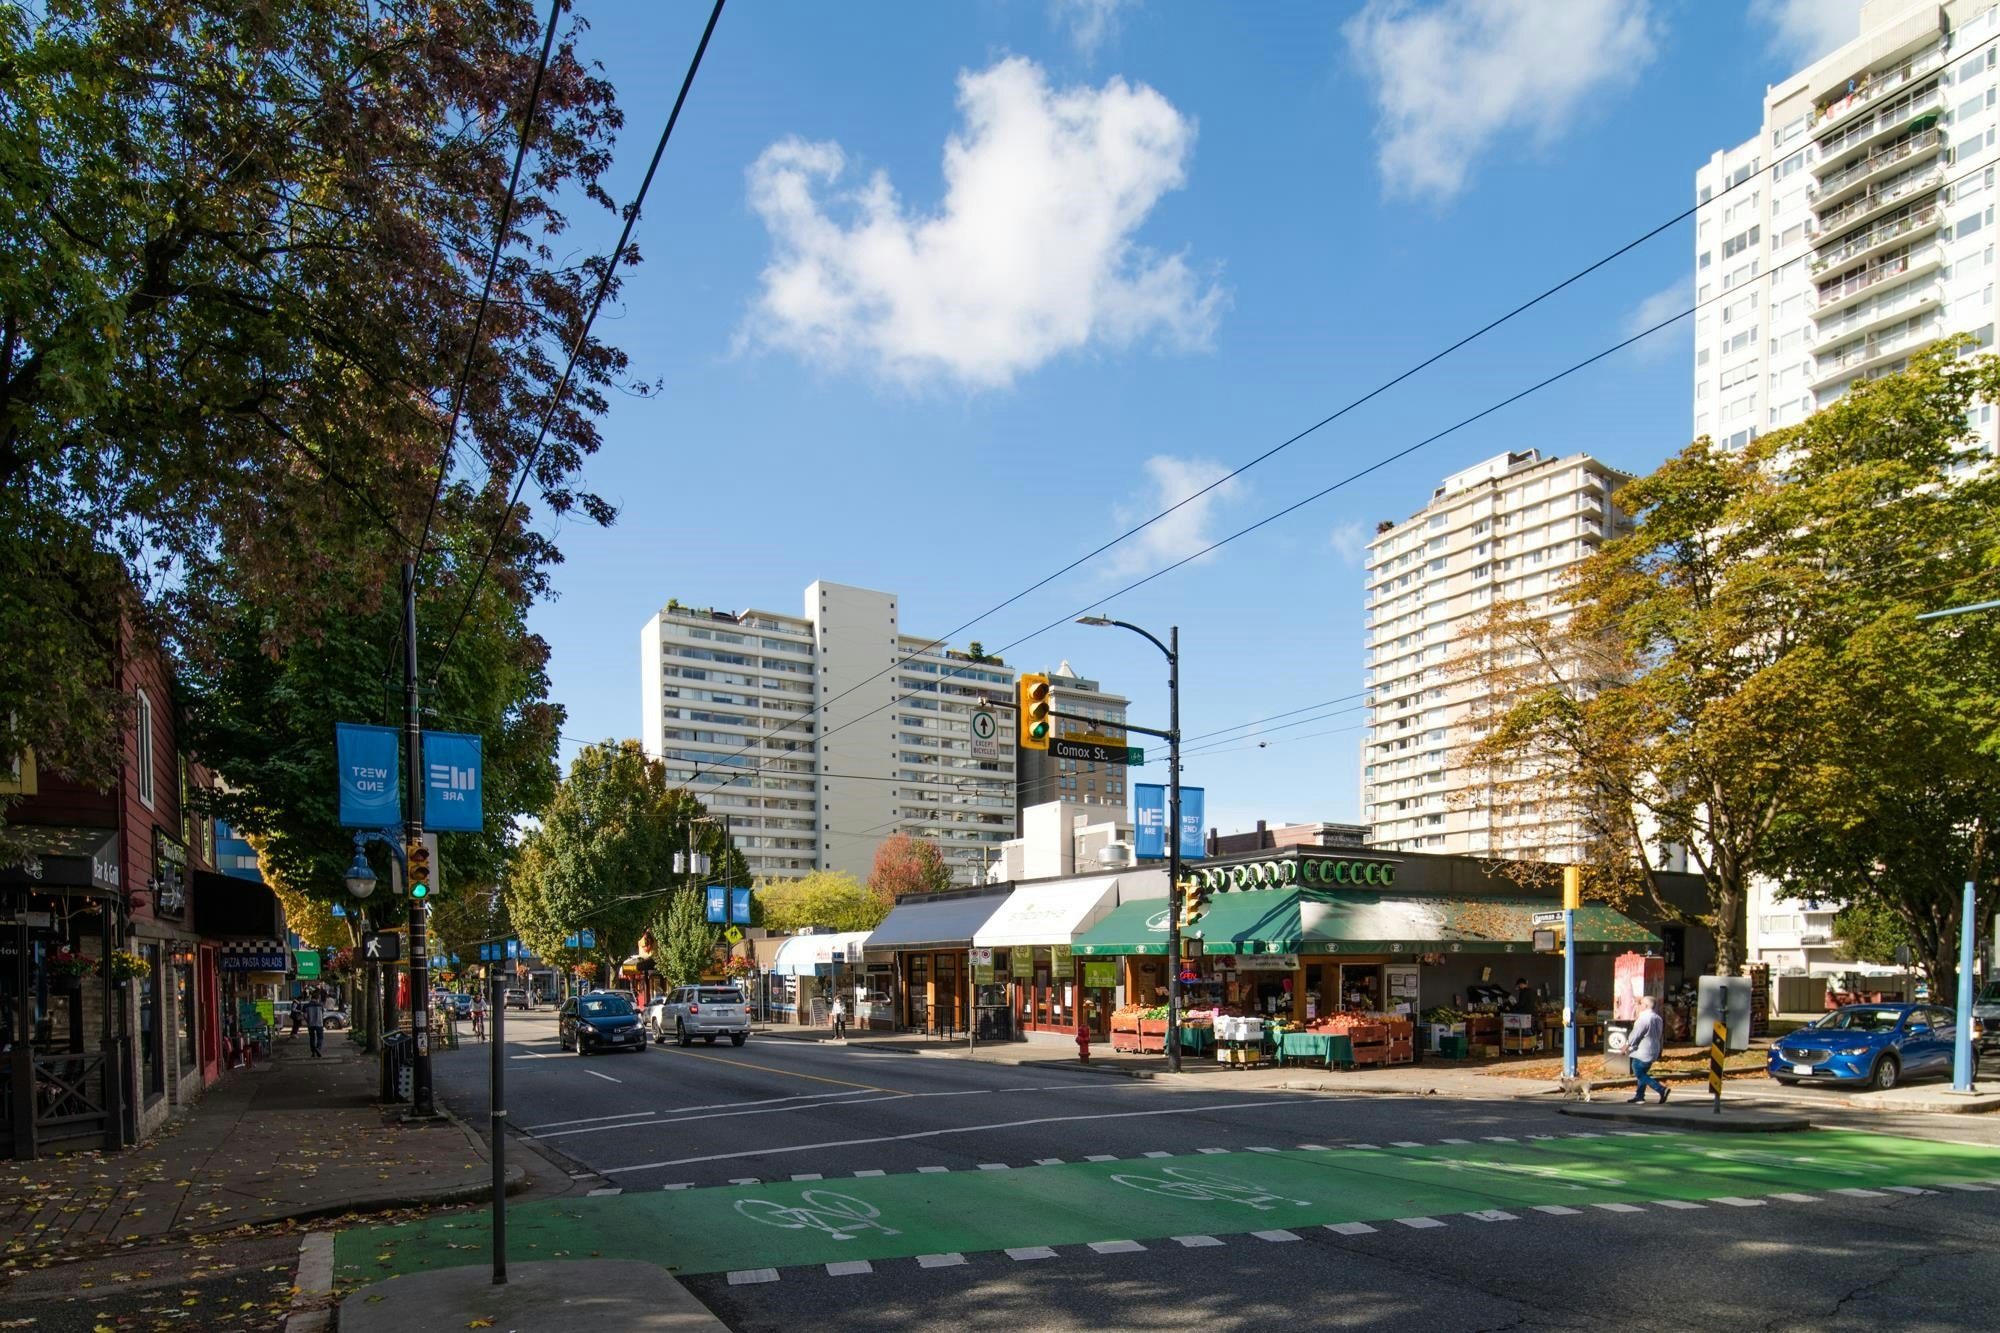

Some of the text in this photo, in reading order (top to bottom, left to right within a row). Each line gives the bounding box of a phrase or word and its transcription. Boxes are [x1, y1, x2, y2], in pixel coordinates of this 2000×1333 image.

[975, 740, 993, 748] EXCEPT
[973, 747, 996, 756] BICYCLES
[1056, 742, 1109, 760] Comox St.
[1138, 808, 1163, 826] WE
[1182, 815, 1200, 825] WEST
[1144, 826, 1157, 835] ARE
[1183, 824, 1198, 834] END
[93, 856, 104, 880] Bar
[103, 861, 109, 883] &
[224, 956, 283, 968] PIZZA PASTA SALADS
